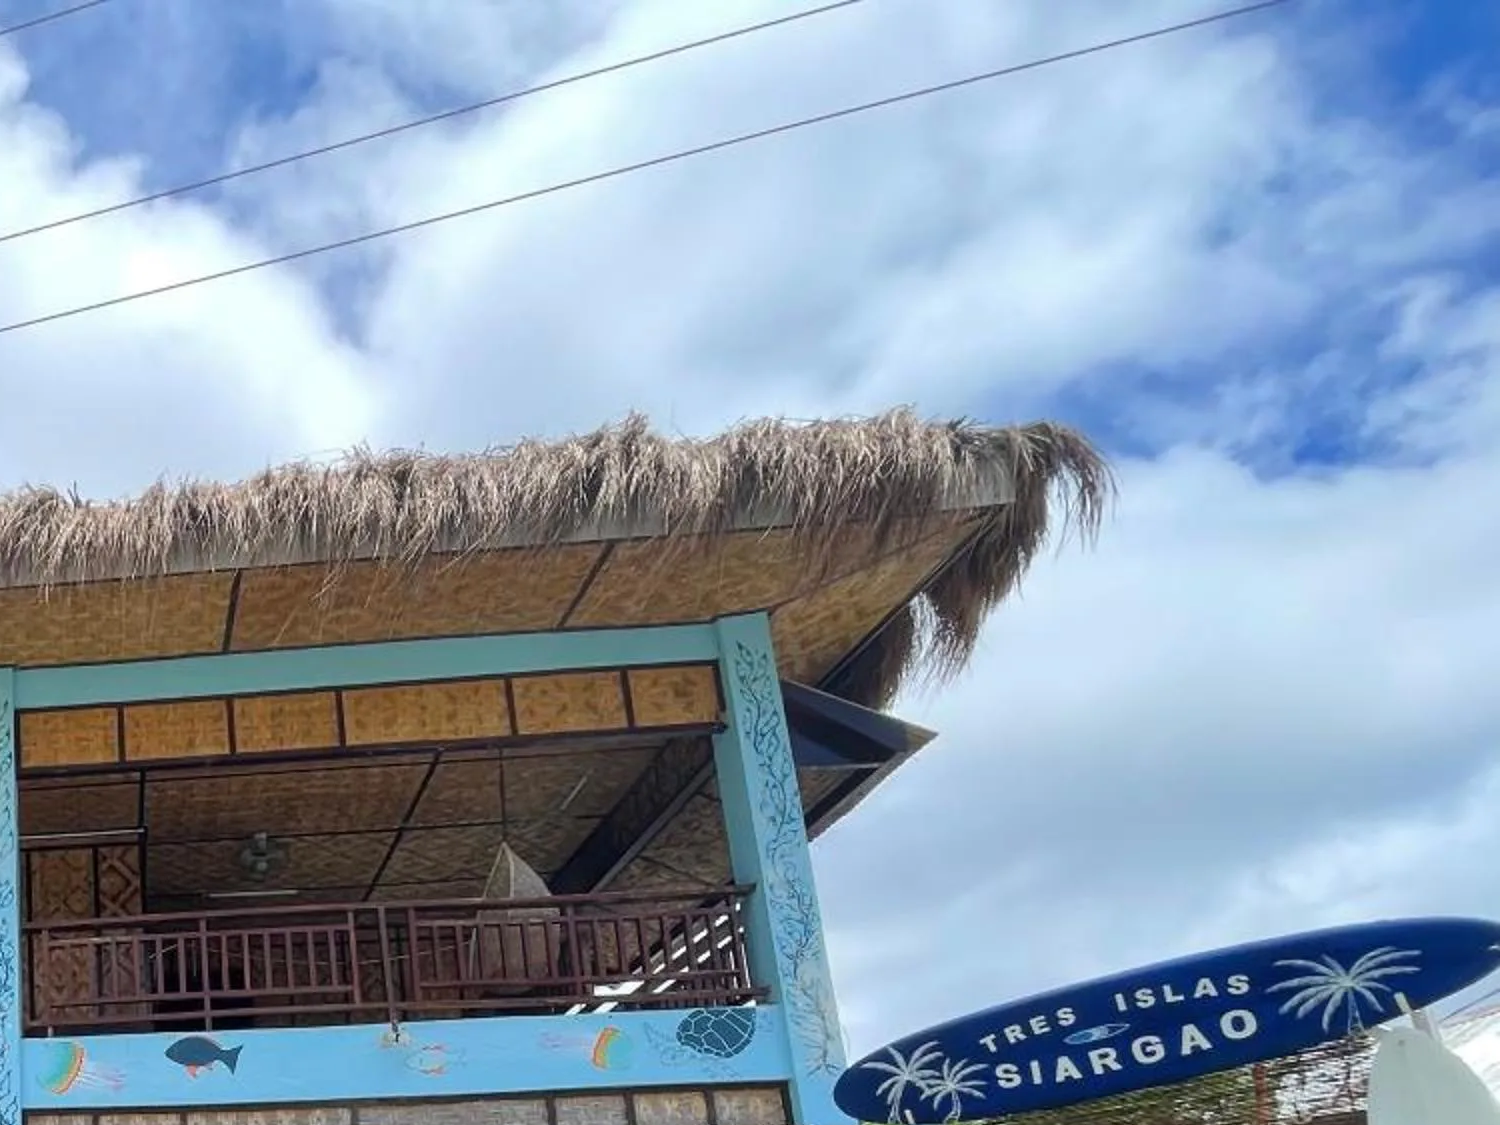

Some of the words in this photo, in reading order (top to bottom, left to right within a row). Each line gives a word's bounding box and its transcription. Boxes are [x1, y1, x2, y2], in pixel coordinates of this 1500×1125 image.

[979, 1007, 1076, 1053] TRES
[1113, 974, 1250, 1012] ISLAS
[995, 1009, 1257, 1089] SIARGAO
